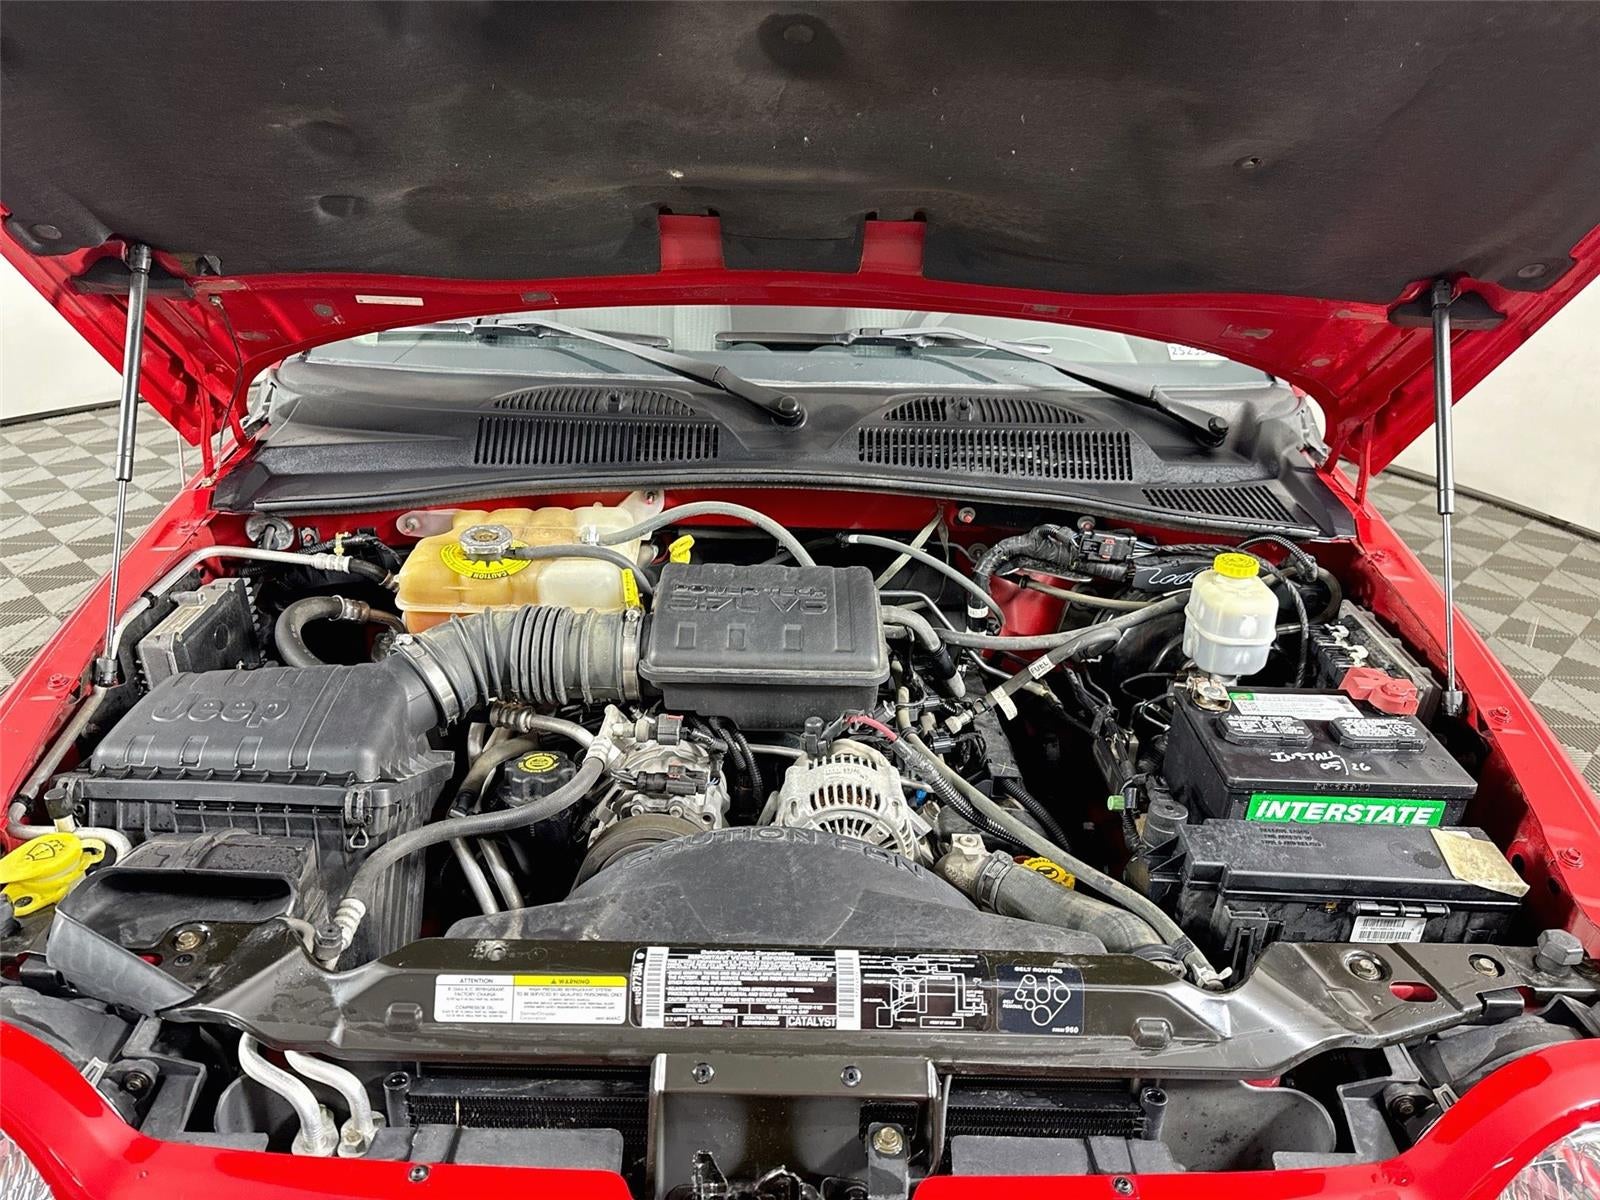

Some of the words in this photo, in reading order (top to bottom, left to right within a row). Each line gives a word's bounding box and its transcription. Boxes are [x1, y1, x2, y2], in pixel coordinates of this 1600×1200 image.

[472, 570, 508, 579] CAUTION
[1030, 661, 1049, 674] FUEL
[151, 694, 290, 728] Jeep
[1254, 800, 1436, 825] INTERSTATE
[788, 1016, 836, 1027] CATALYST
